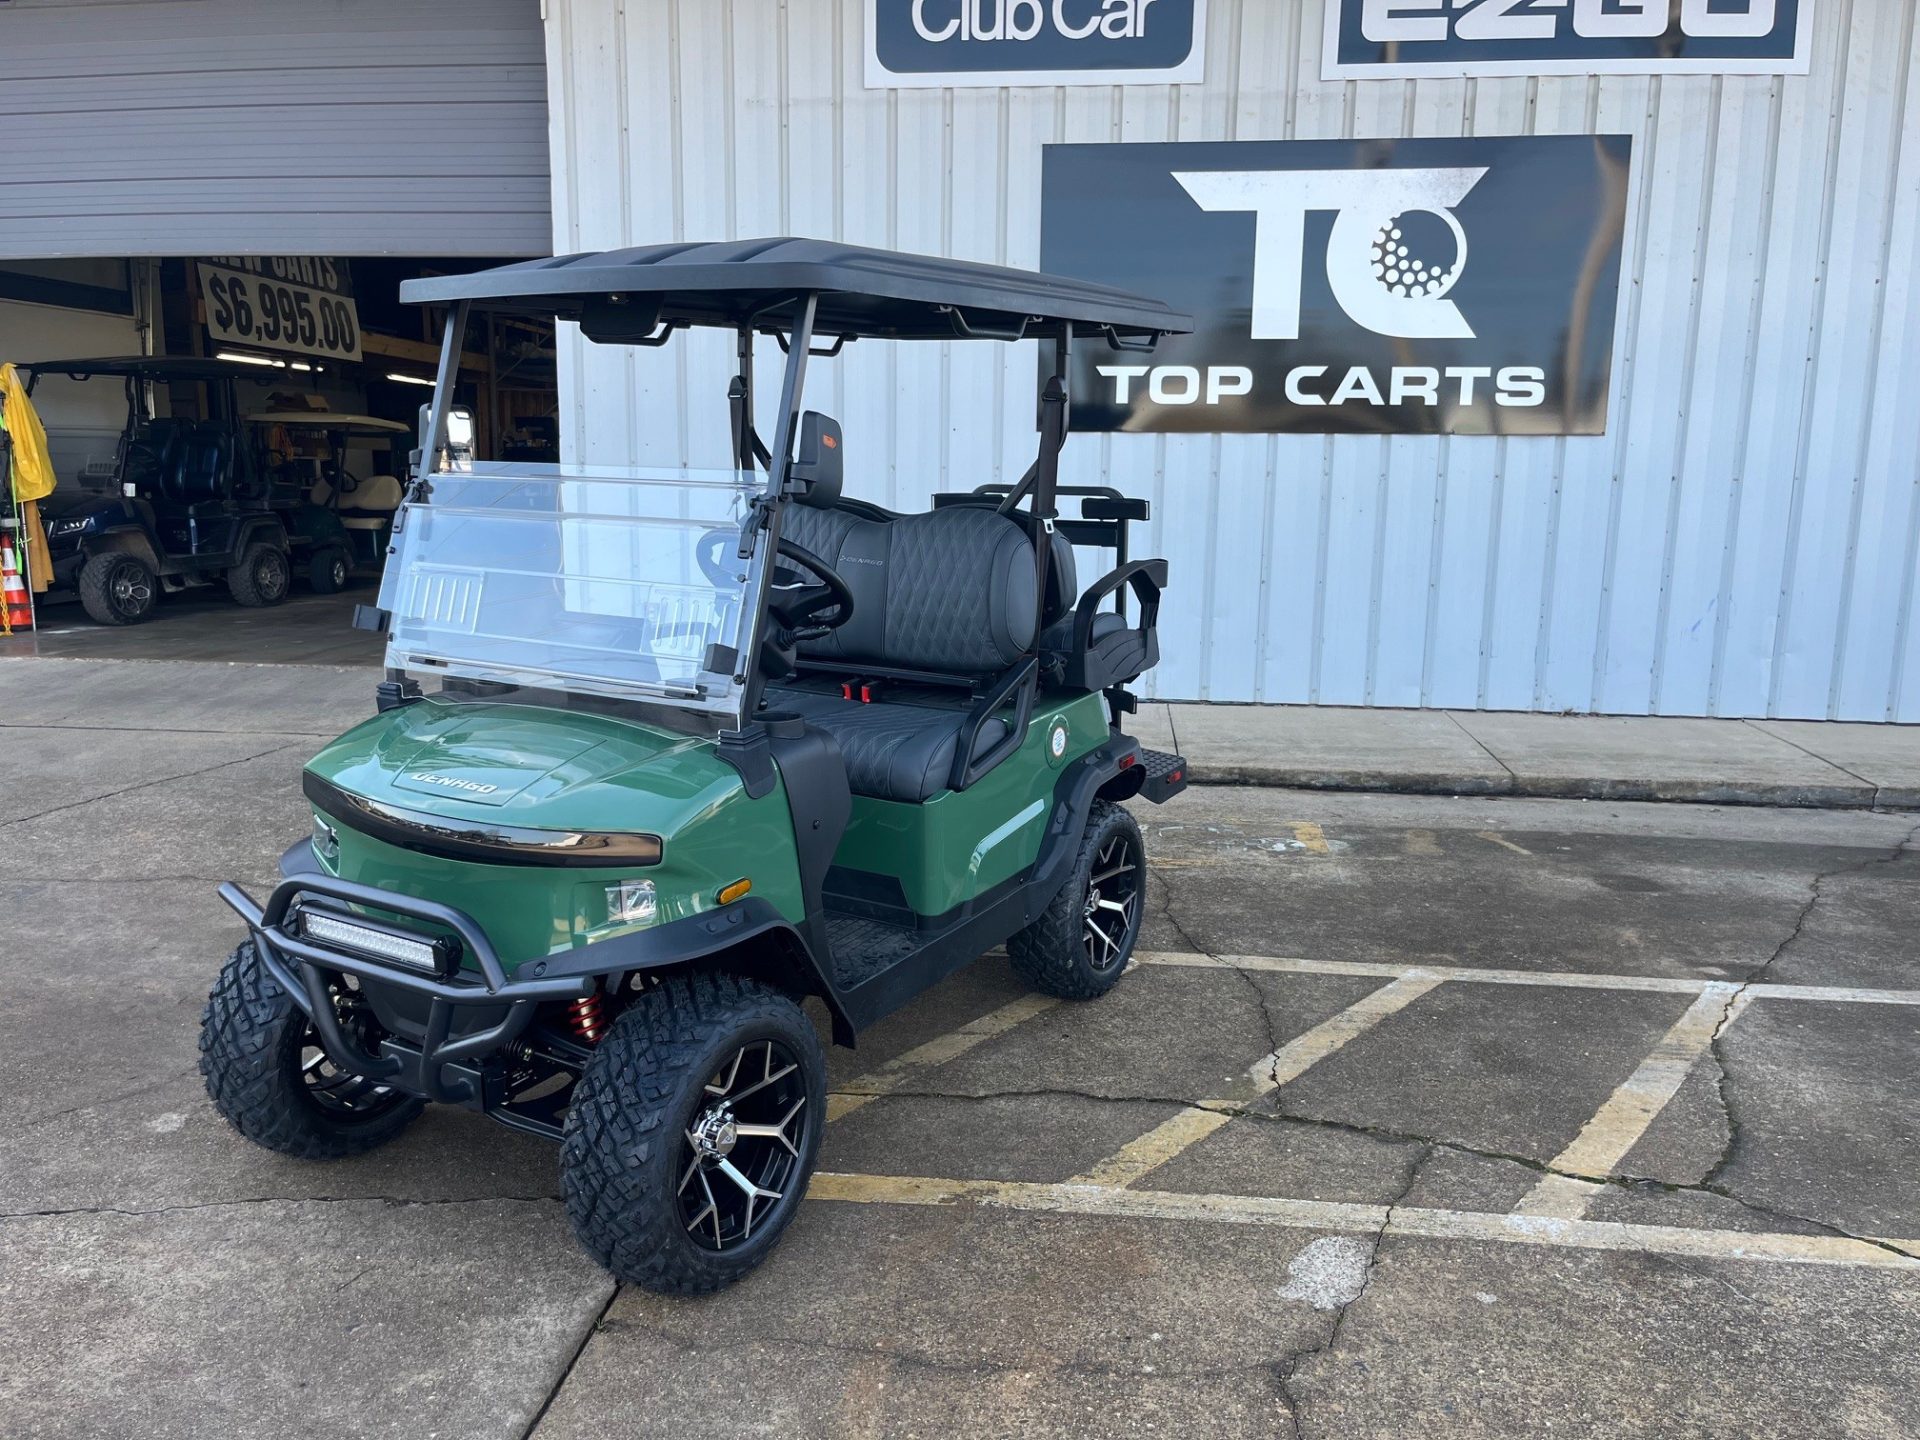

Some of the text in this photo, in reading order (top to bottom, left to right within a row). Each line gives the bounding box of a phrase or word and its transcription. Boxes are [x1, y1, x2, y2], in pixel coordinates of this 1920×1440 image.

[911, 0, 1149, 42] Club Car
[209, 272, 355, 353] $6,995.00
[1095, 365, 1546, 407] TOP CARTS
